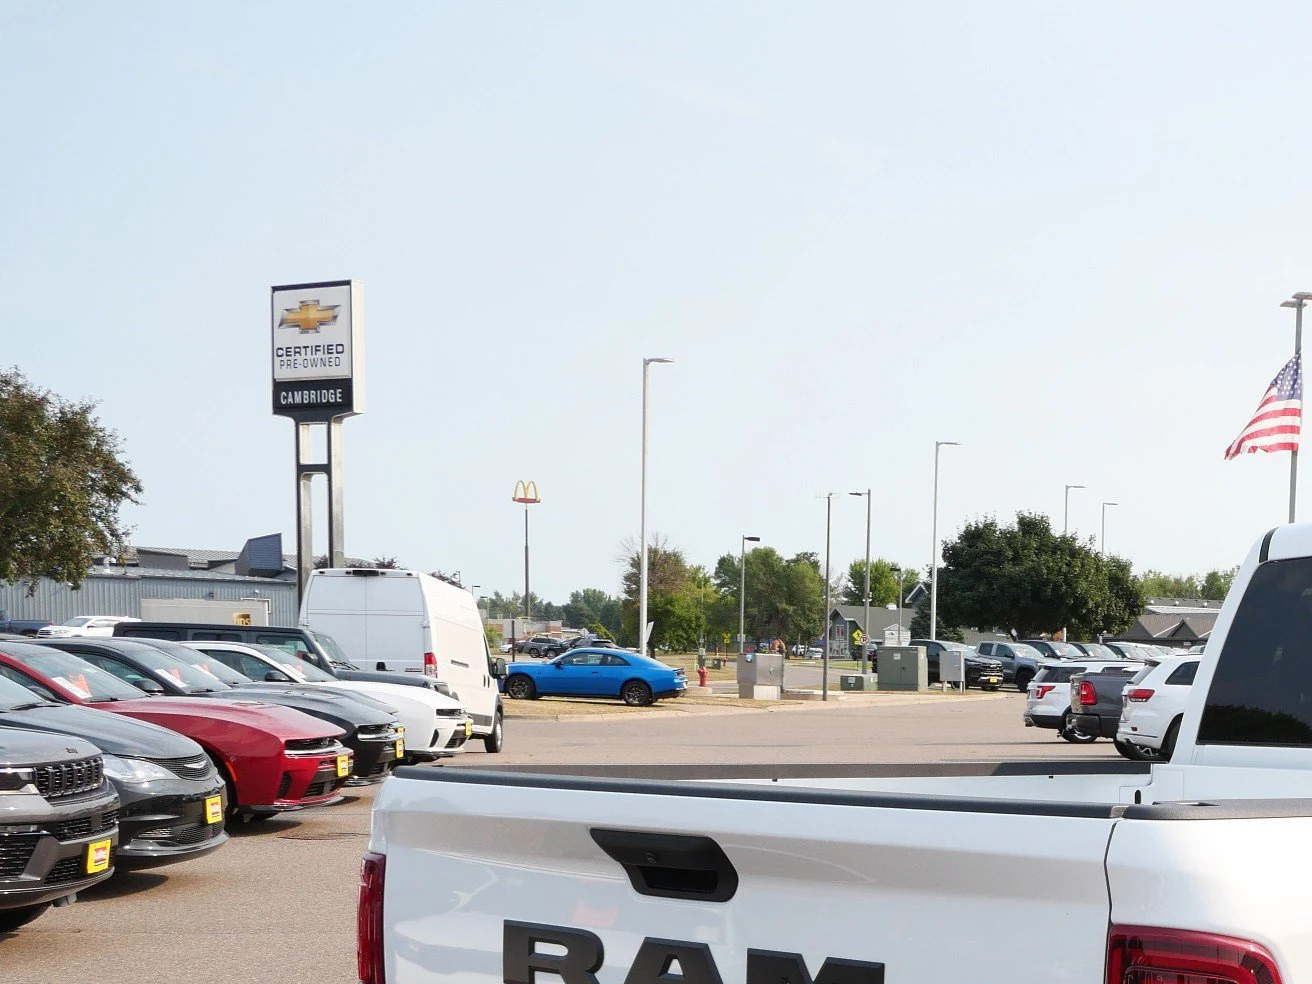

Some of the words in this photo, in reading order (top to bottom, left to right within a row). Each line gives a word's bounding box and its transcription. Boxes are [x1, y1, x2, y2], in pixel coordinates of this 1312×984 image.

[276, 343, 345, 358] CERTIFIED
[279, 356, 341, 369] PRE-OWNED
[280, 388, 343, 405] CAMBRIDGE
